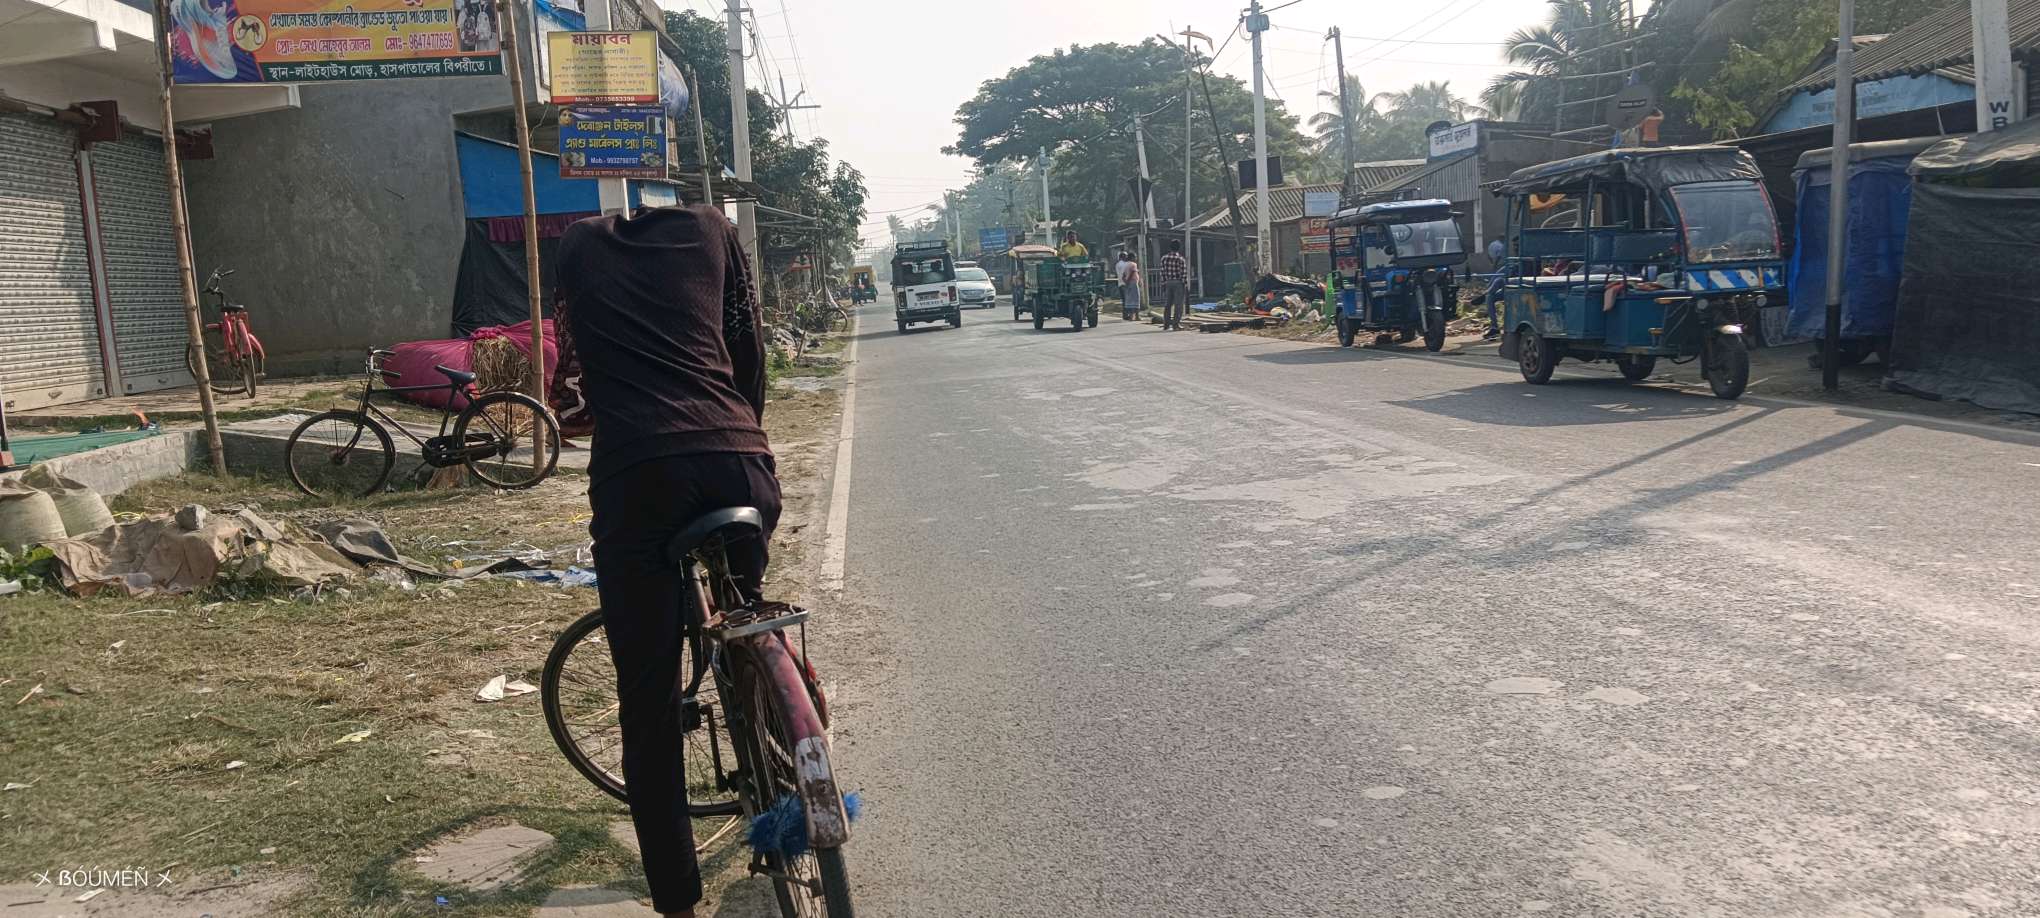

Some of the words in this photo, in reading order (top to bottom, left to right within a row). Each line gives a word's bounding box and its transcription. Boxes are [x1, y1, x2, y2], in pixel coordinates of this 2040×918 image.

[270, 12, 297, 27] এখানে
[298, 12, 318, 27] সমস্ত
[409, 9, 433, 25] পাওয়া
[571, 33, 633, 46] মায়াবন
[379, 62, 441, 76] হাসপাতালের
[642, 136, 658, 149] লিঃ
